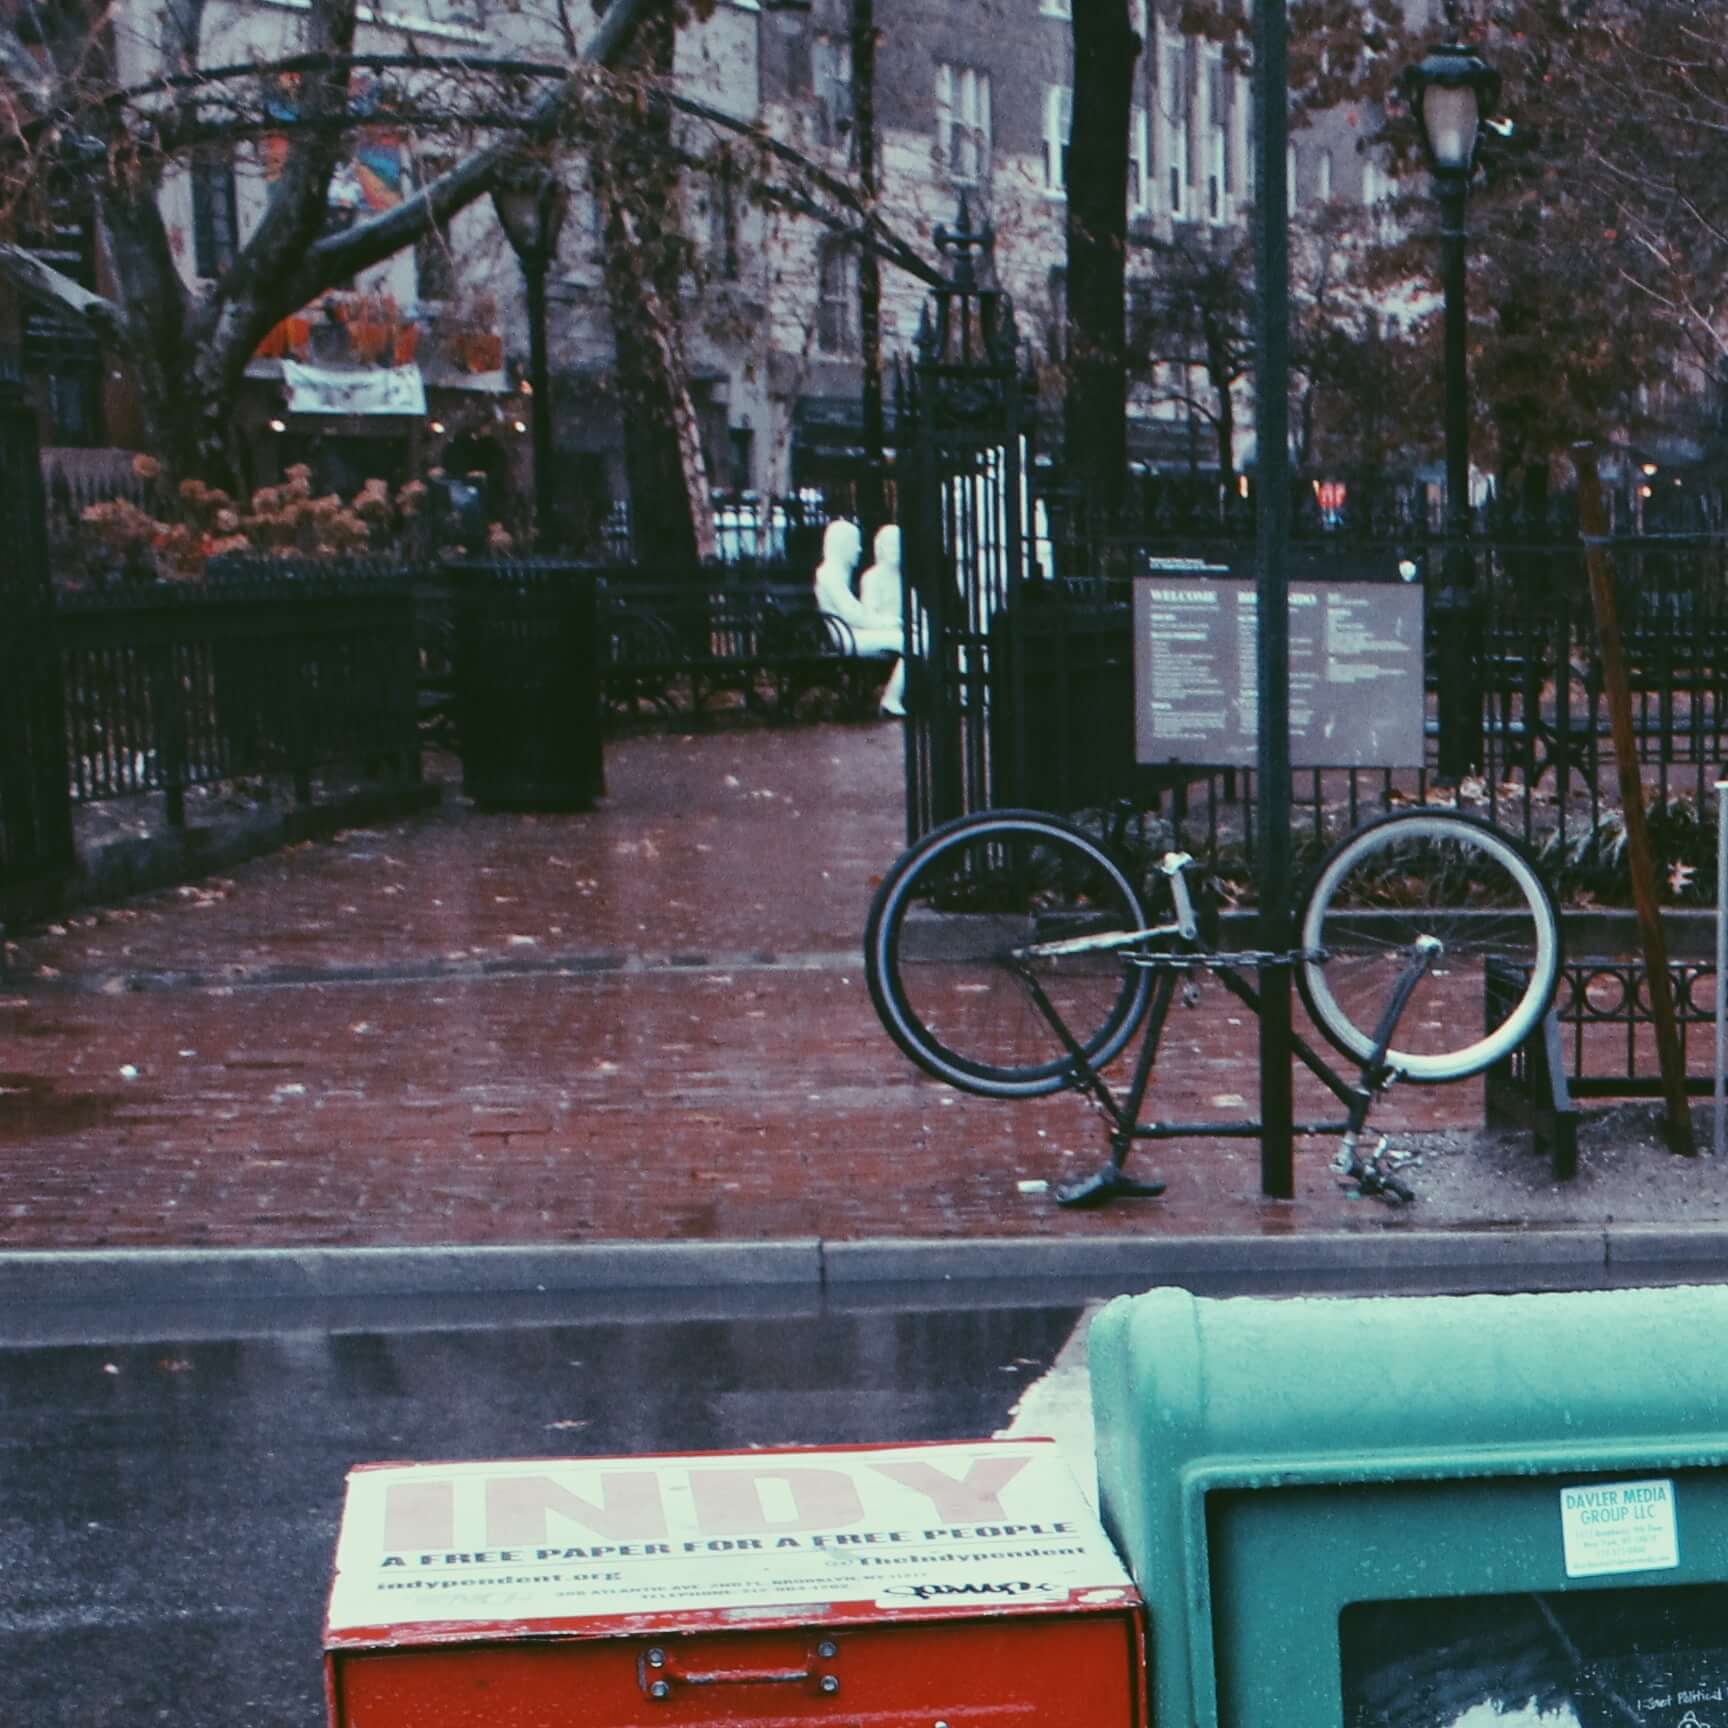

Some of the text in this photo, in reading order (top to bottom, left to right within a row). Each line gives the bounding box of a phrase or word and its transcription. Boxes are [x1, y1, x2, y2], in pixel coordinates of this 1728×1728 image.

[382, 1456, 1033, 1553] INDY
[1566, 1487, 1667, 1510] DAVLER MEDIA
[1580, 1504, 1657, 1525] GROUP LLC
[381, 1521, 1080, 1569] A FREE PAPER FOR A FREE PEOPLE
[376, 1570, 623, 1591] indypendent.org
[1677, 1687, 1723, 1705] Political
